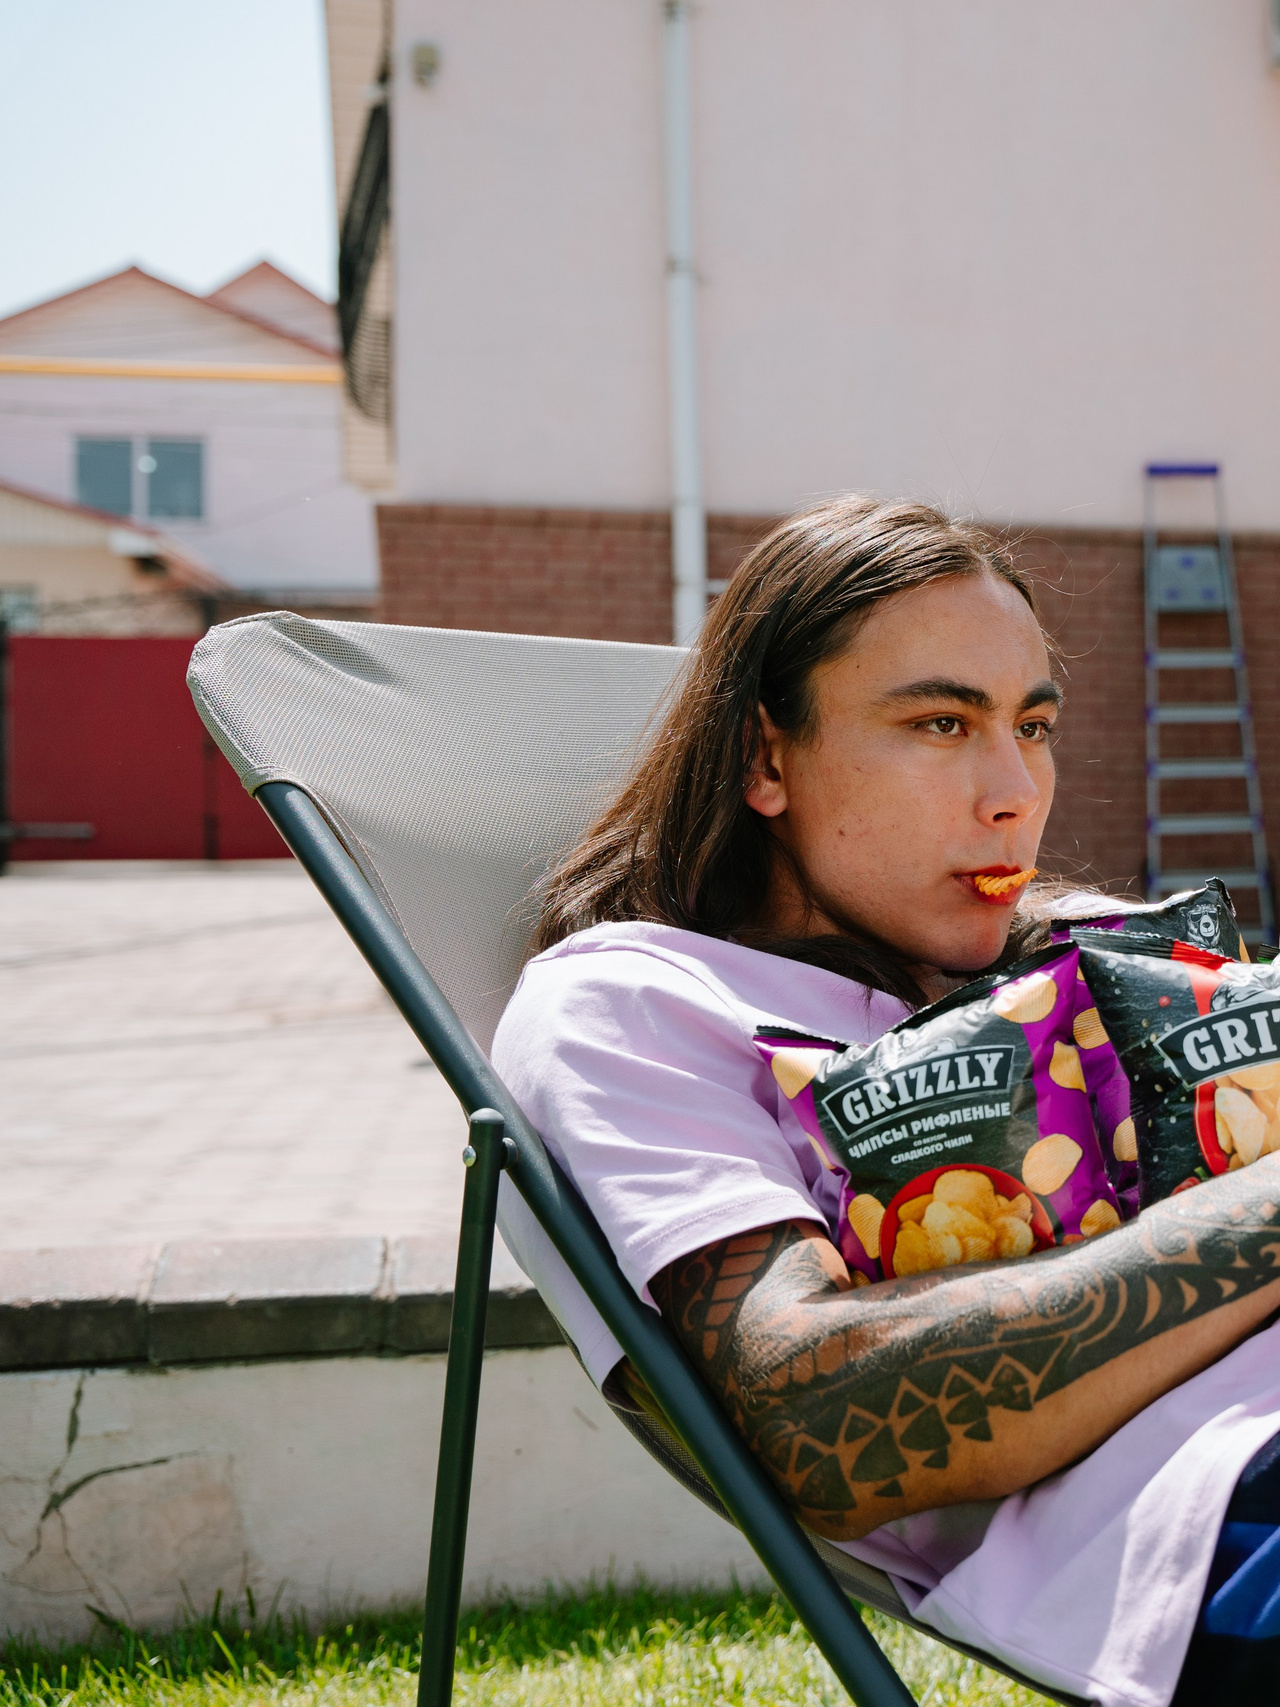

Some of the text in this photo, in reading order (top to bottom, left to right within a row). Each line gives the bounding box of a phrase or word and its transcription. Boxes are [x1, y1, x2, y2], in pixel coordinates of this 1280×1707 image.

[842, 1052, 1003, 1125] GRIZZLY
[848, 1102, 1011, 1159] ЧИПСЫ РИФЛЕНЫЕ
[891, 1134, 973, 1165] СЛАДКОГО ЧИЛИ
